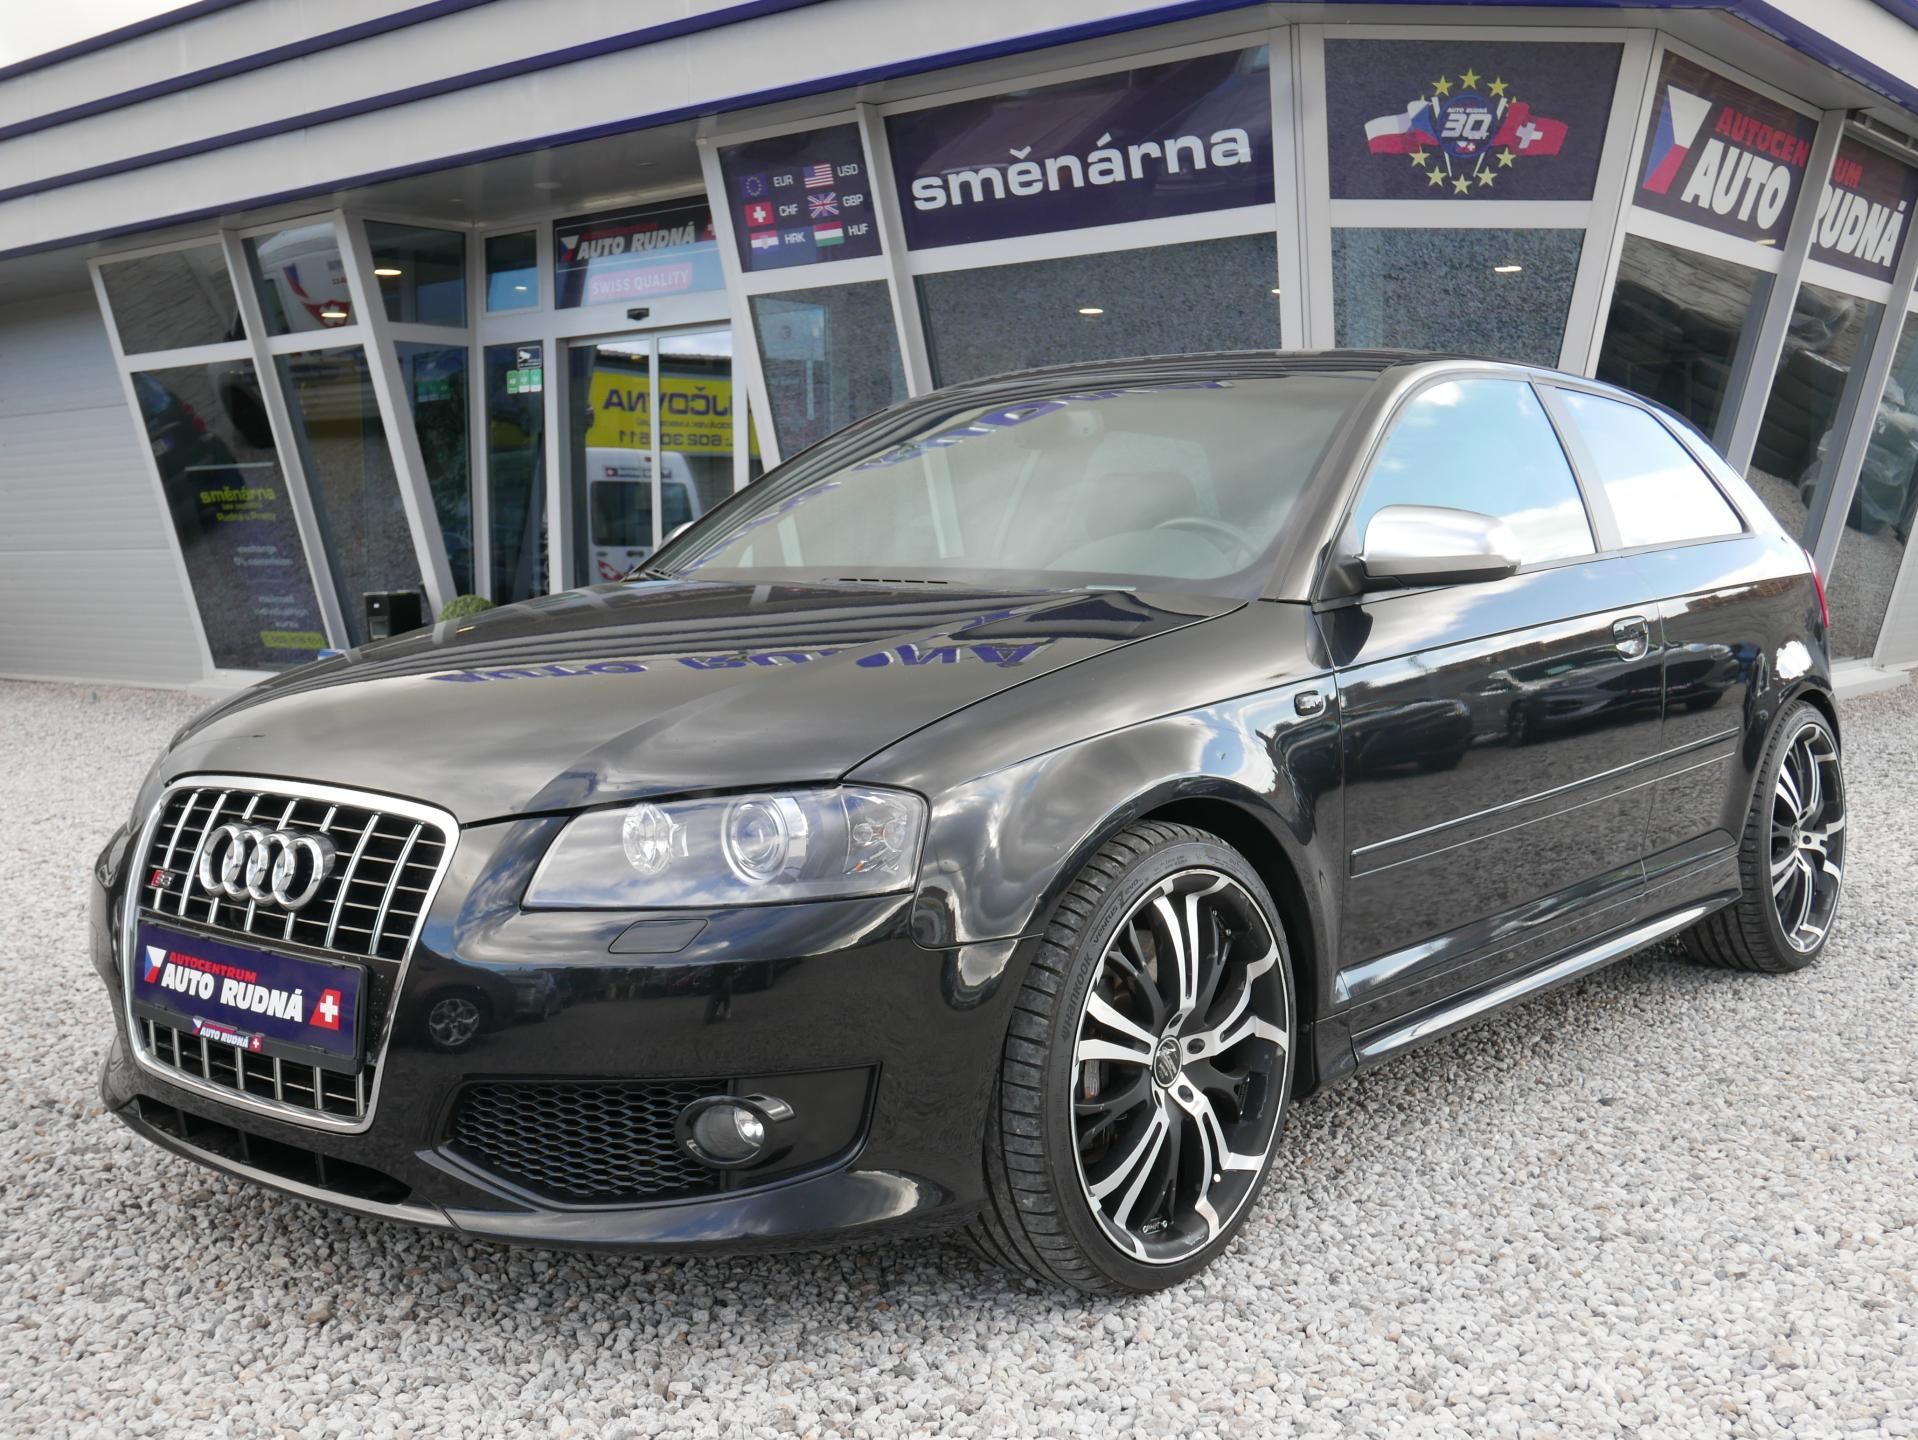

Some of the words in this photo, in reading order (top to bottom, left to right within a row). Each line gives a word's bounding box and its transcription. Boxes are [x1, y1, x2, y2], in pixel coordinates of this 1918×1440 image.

[1441, 113, 1493, 139] 30
[773, 175, 794, 187] EUR
[837, 164, 859, 176] USD
[911, 128, 1252, 211] směnárna
[1681, 138, 1791, 230] AUTO
[779, 204, 799, 216] CHF
[842, 194, 864, 207] GBP
[576, 235, 625, 260] AUTO
[630, 221, 695, 252] RUDNÁ
[784, 232, 806, 244] HRK
[848, 223, 869, 236] HUF
[592, 278, 631, 295] SWISS
[633, 270, 689, 290] QUALITY
[169, 951, 257, 983] AUTOCENTRUM
[161, 963, 215, 1000] AUTO
[220, 978, 303, 1022] RUDNÁ
[200, 1026, 220, 1040] AUTO
[220, 1032, 249, 1048] RUDNÁ
